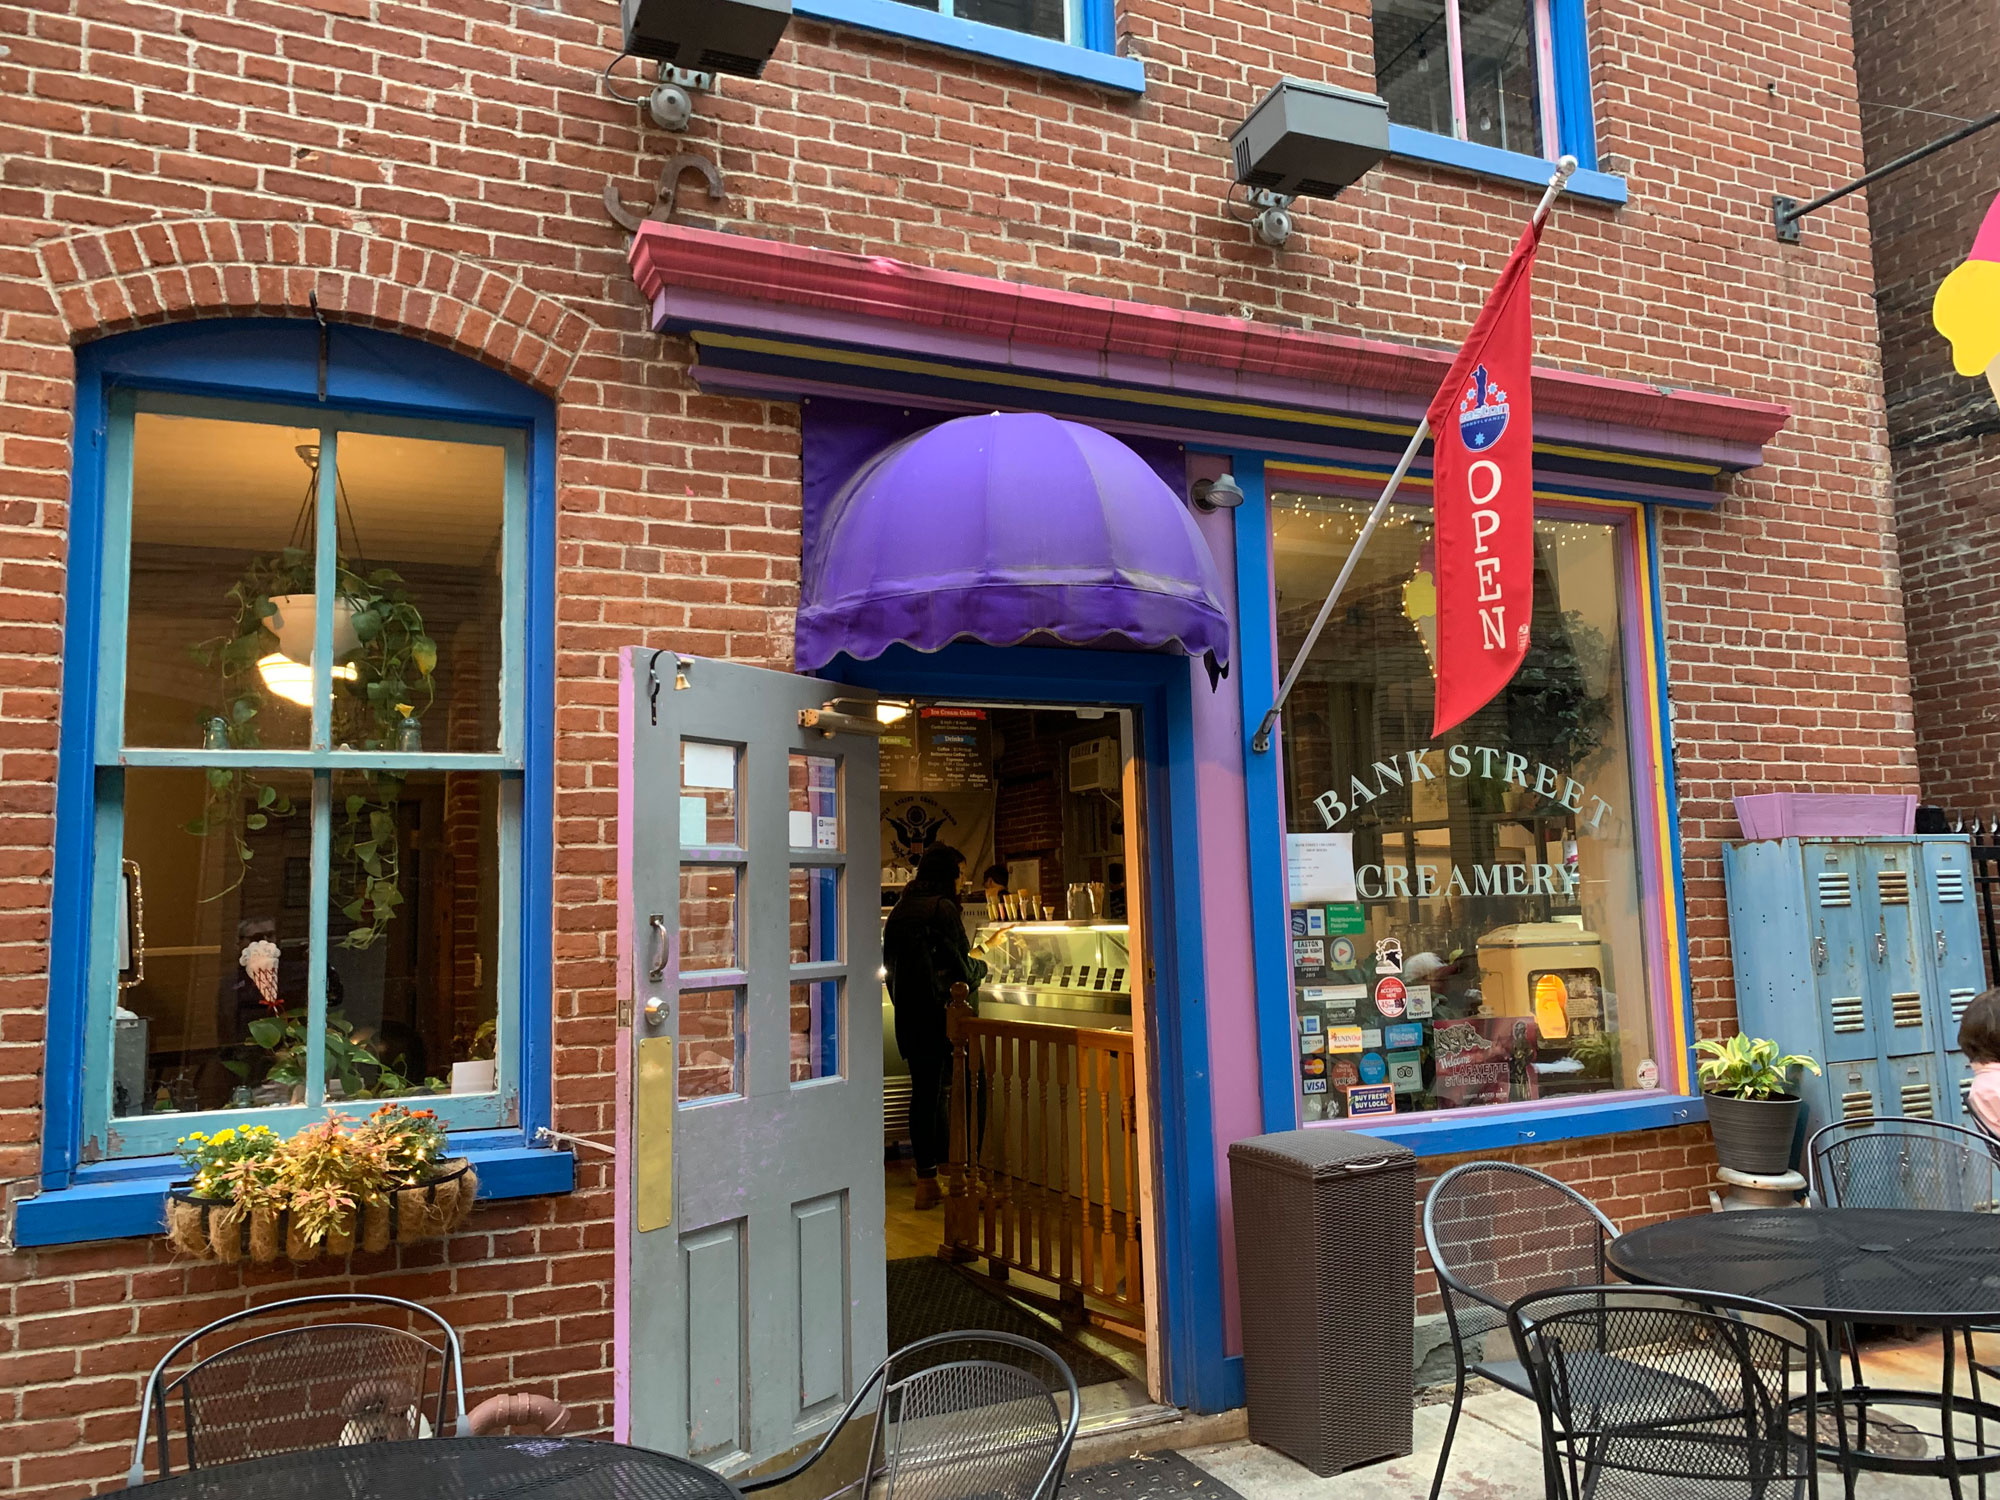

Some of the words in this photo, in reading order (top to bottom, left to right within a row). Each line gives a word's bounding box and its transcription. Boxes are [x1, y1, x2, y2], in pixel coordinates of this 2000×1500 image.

[1460, 403, 1509, 423] easton
[1466, 459, 1506, 651] OPEN
[1313, 748, 1436, 831] BANK
[1448, 744, 1613, 829] STREET
[1355, 862, 1579, 899] CREAMERY
[1439, 1055, 1472, 1069] Welcome
[1453, 1062, 1508, 1076] LAFAYETTE
[1307, 1081, 1326, 1091] VISA
[1445, 1073, 1498, 1087] STUDENTS!
[1355, 1101, 1368, 1109] BUY
